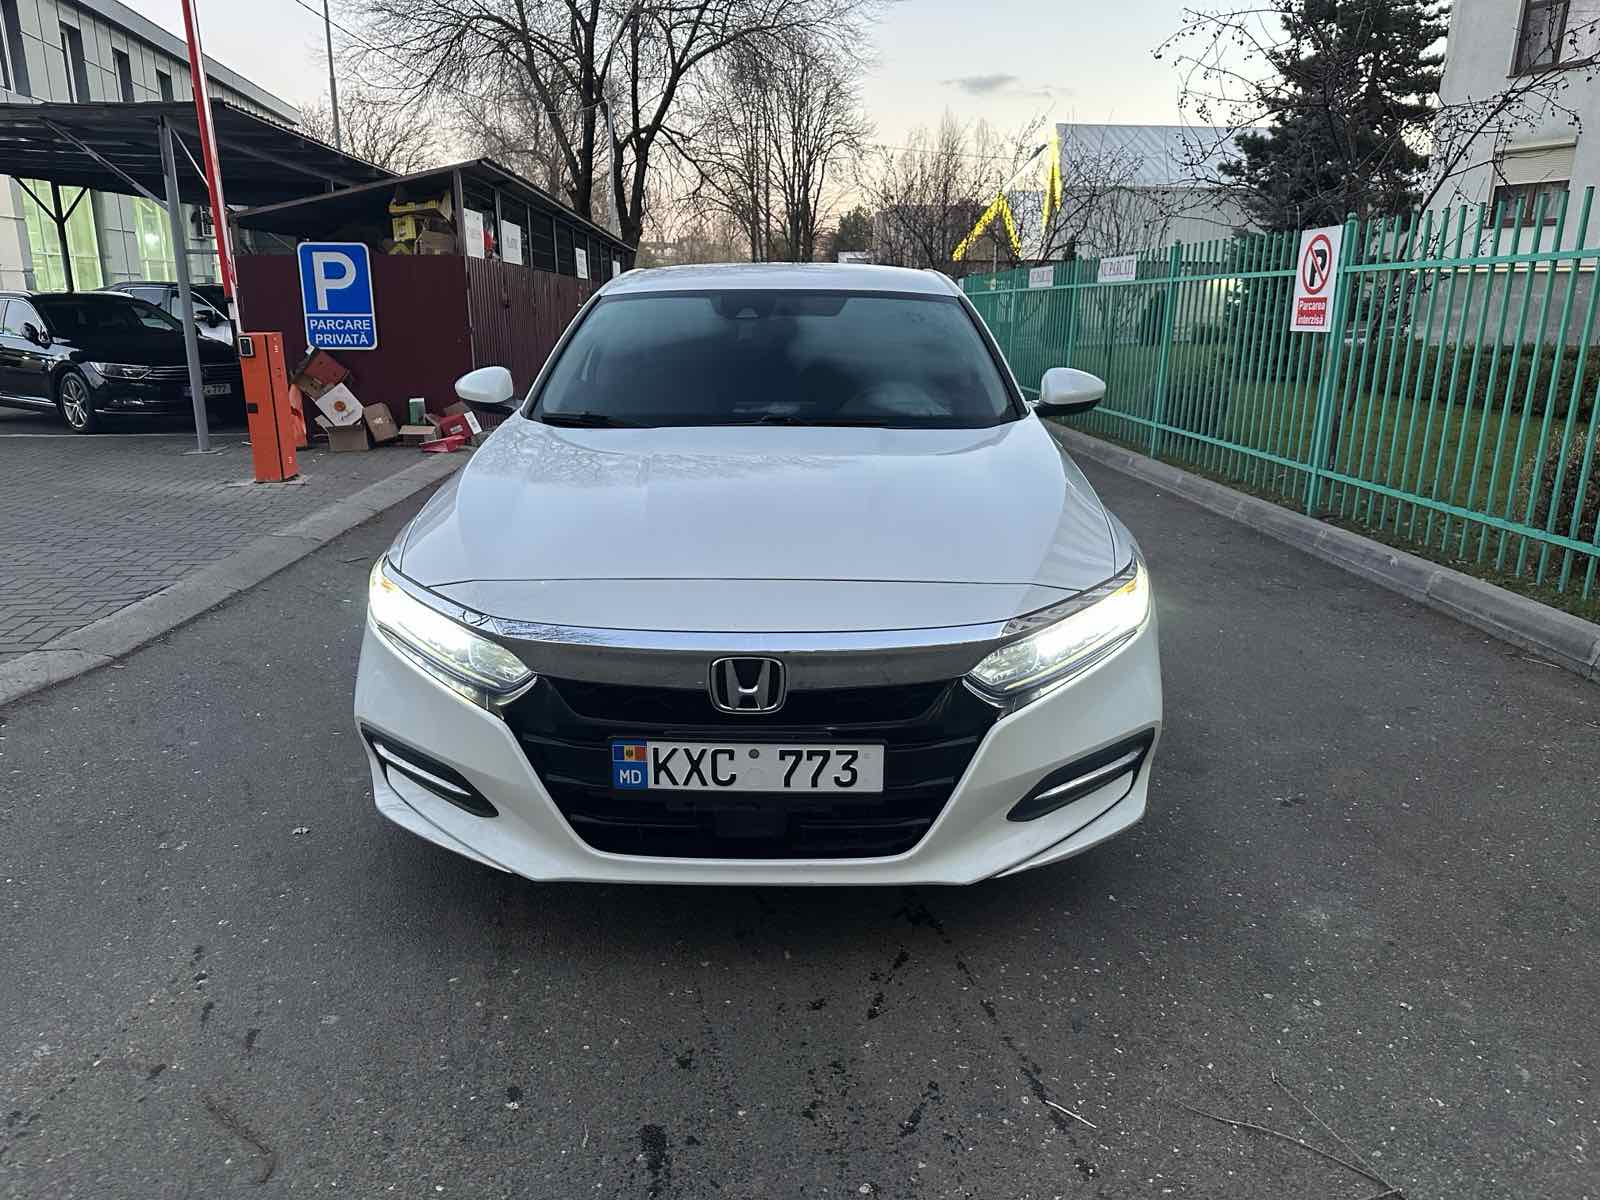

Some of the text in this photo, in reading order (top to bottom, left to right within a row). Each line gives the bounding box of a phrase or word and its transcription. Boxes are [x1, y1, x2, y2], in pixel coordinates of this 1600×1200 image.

[312, 251, 357, 311] P
[1299, 301, 1325, 311] Parcarea
[309, 319, 371, 330] PARCARE
[315, 331, 369, 344] PRIVATĂ
[652, 747, 859, 788] KXC 773
[619, 769, 642, 785] MD
